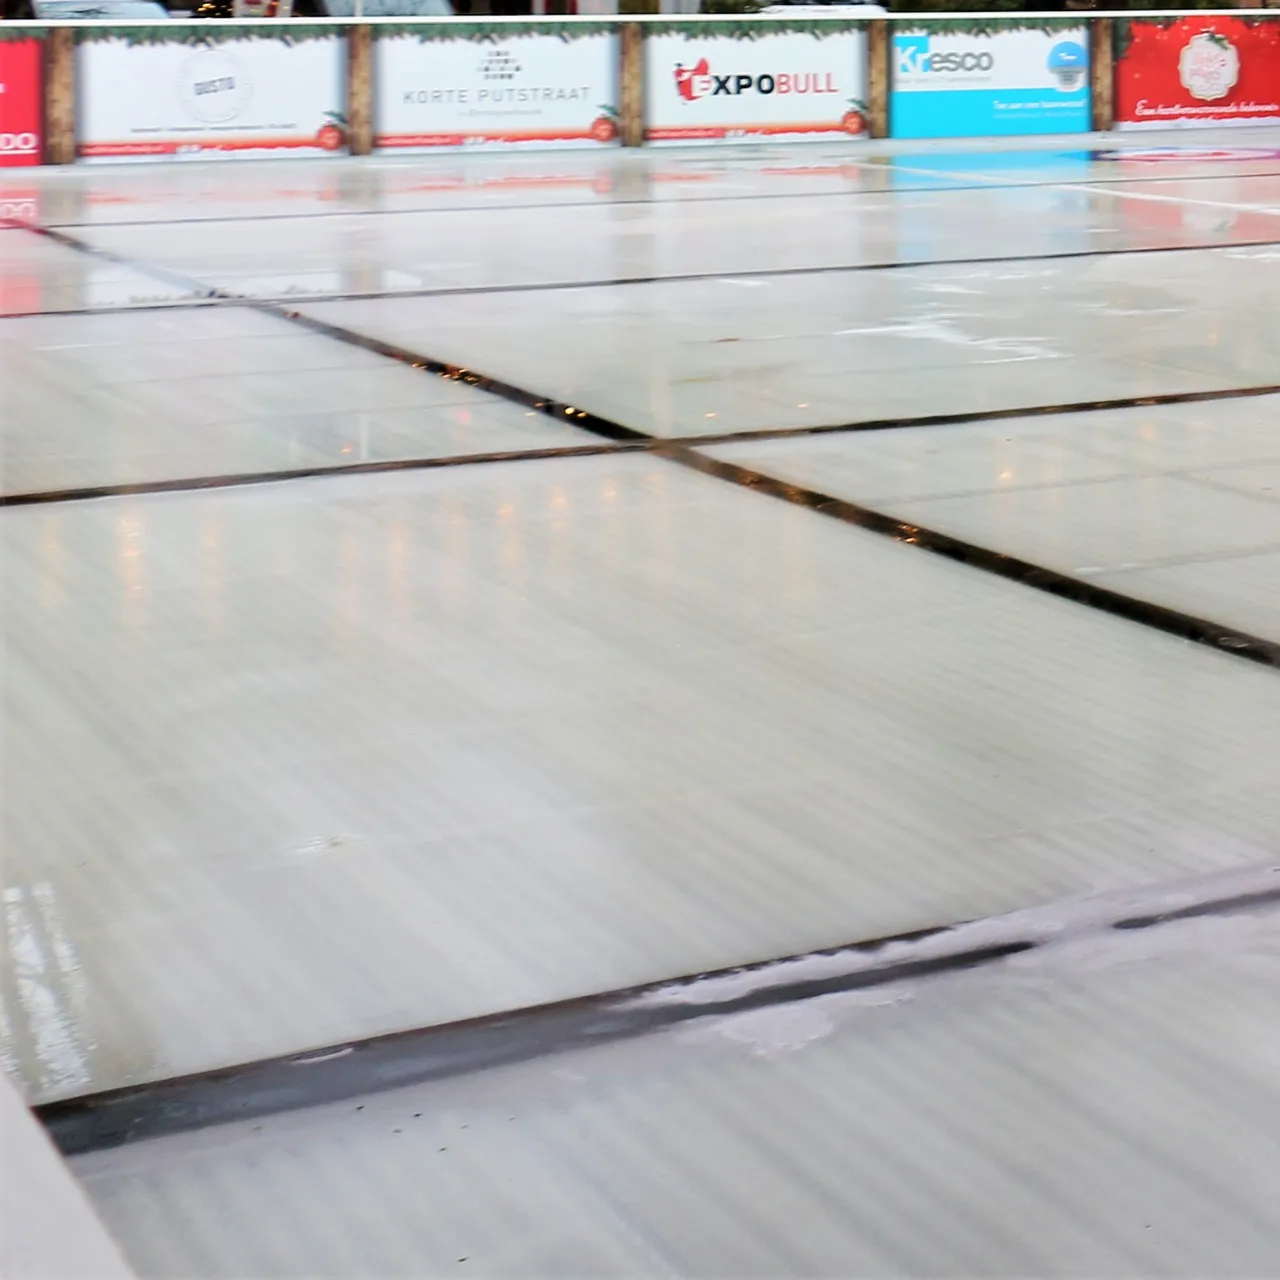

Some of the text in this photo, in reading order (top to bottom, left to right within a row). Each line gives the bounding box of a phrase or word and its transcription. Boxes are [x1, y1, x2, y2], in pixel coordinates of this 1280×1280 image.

[895, 46, 994, 72] Kresco
[194, 76, 235, 95] GUSTO
[691, 72, 839, 96] EXPOBULL
[403, 86, 590, 104] KORTE PUTSTRAAT
